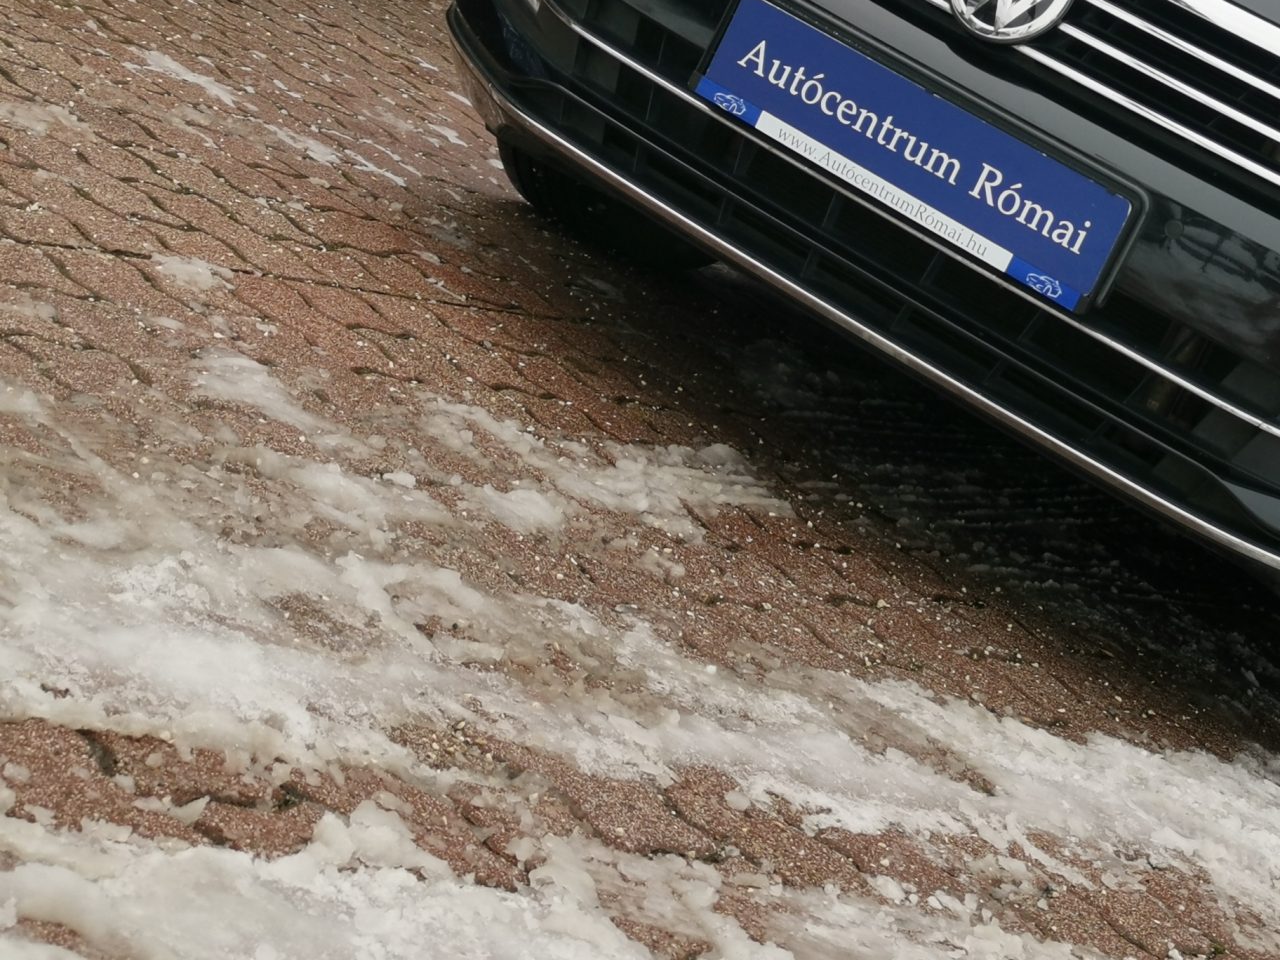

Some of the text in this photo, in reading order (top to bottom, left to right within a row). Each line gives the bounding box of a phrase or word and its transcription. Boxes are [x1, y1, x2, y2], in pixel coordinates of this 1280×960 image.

[737, 39, 1092, 255] Autócentrum Római
[777, 126, 988, 257] www.AutócentrumRómai.hu
